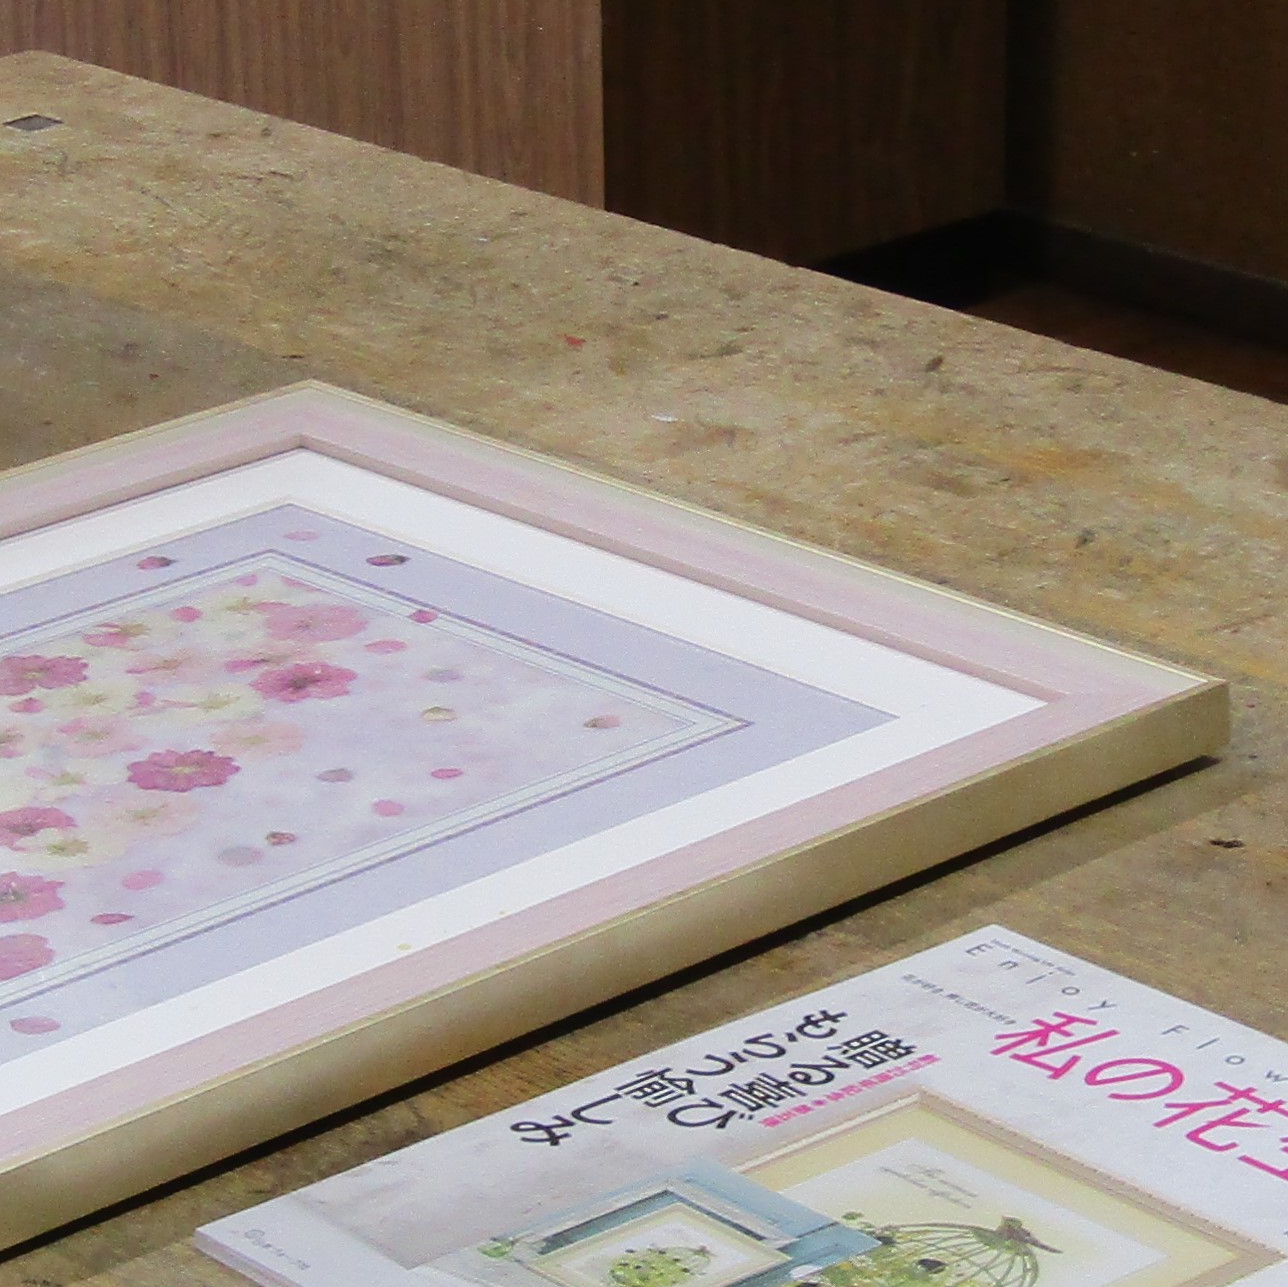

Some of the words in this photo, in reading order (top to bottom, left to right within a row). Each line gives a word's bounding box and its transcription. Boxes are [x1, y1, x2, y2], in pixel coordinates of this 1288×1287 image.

[964, 942, 1118, 1011] Enjoy
[509, 1009, 848, 1147] もらう愉しみ
[666, 1029, 916, 1130] 贈る喜び
